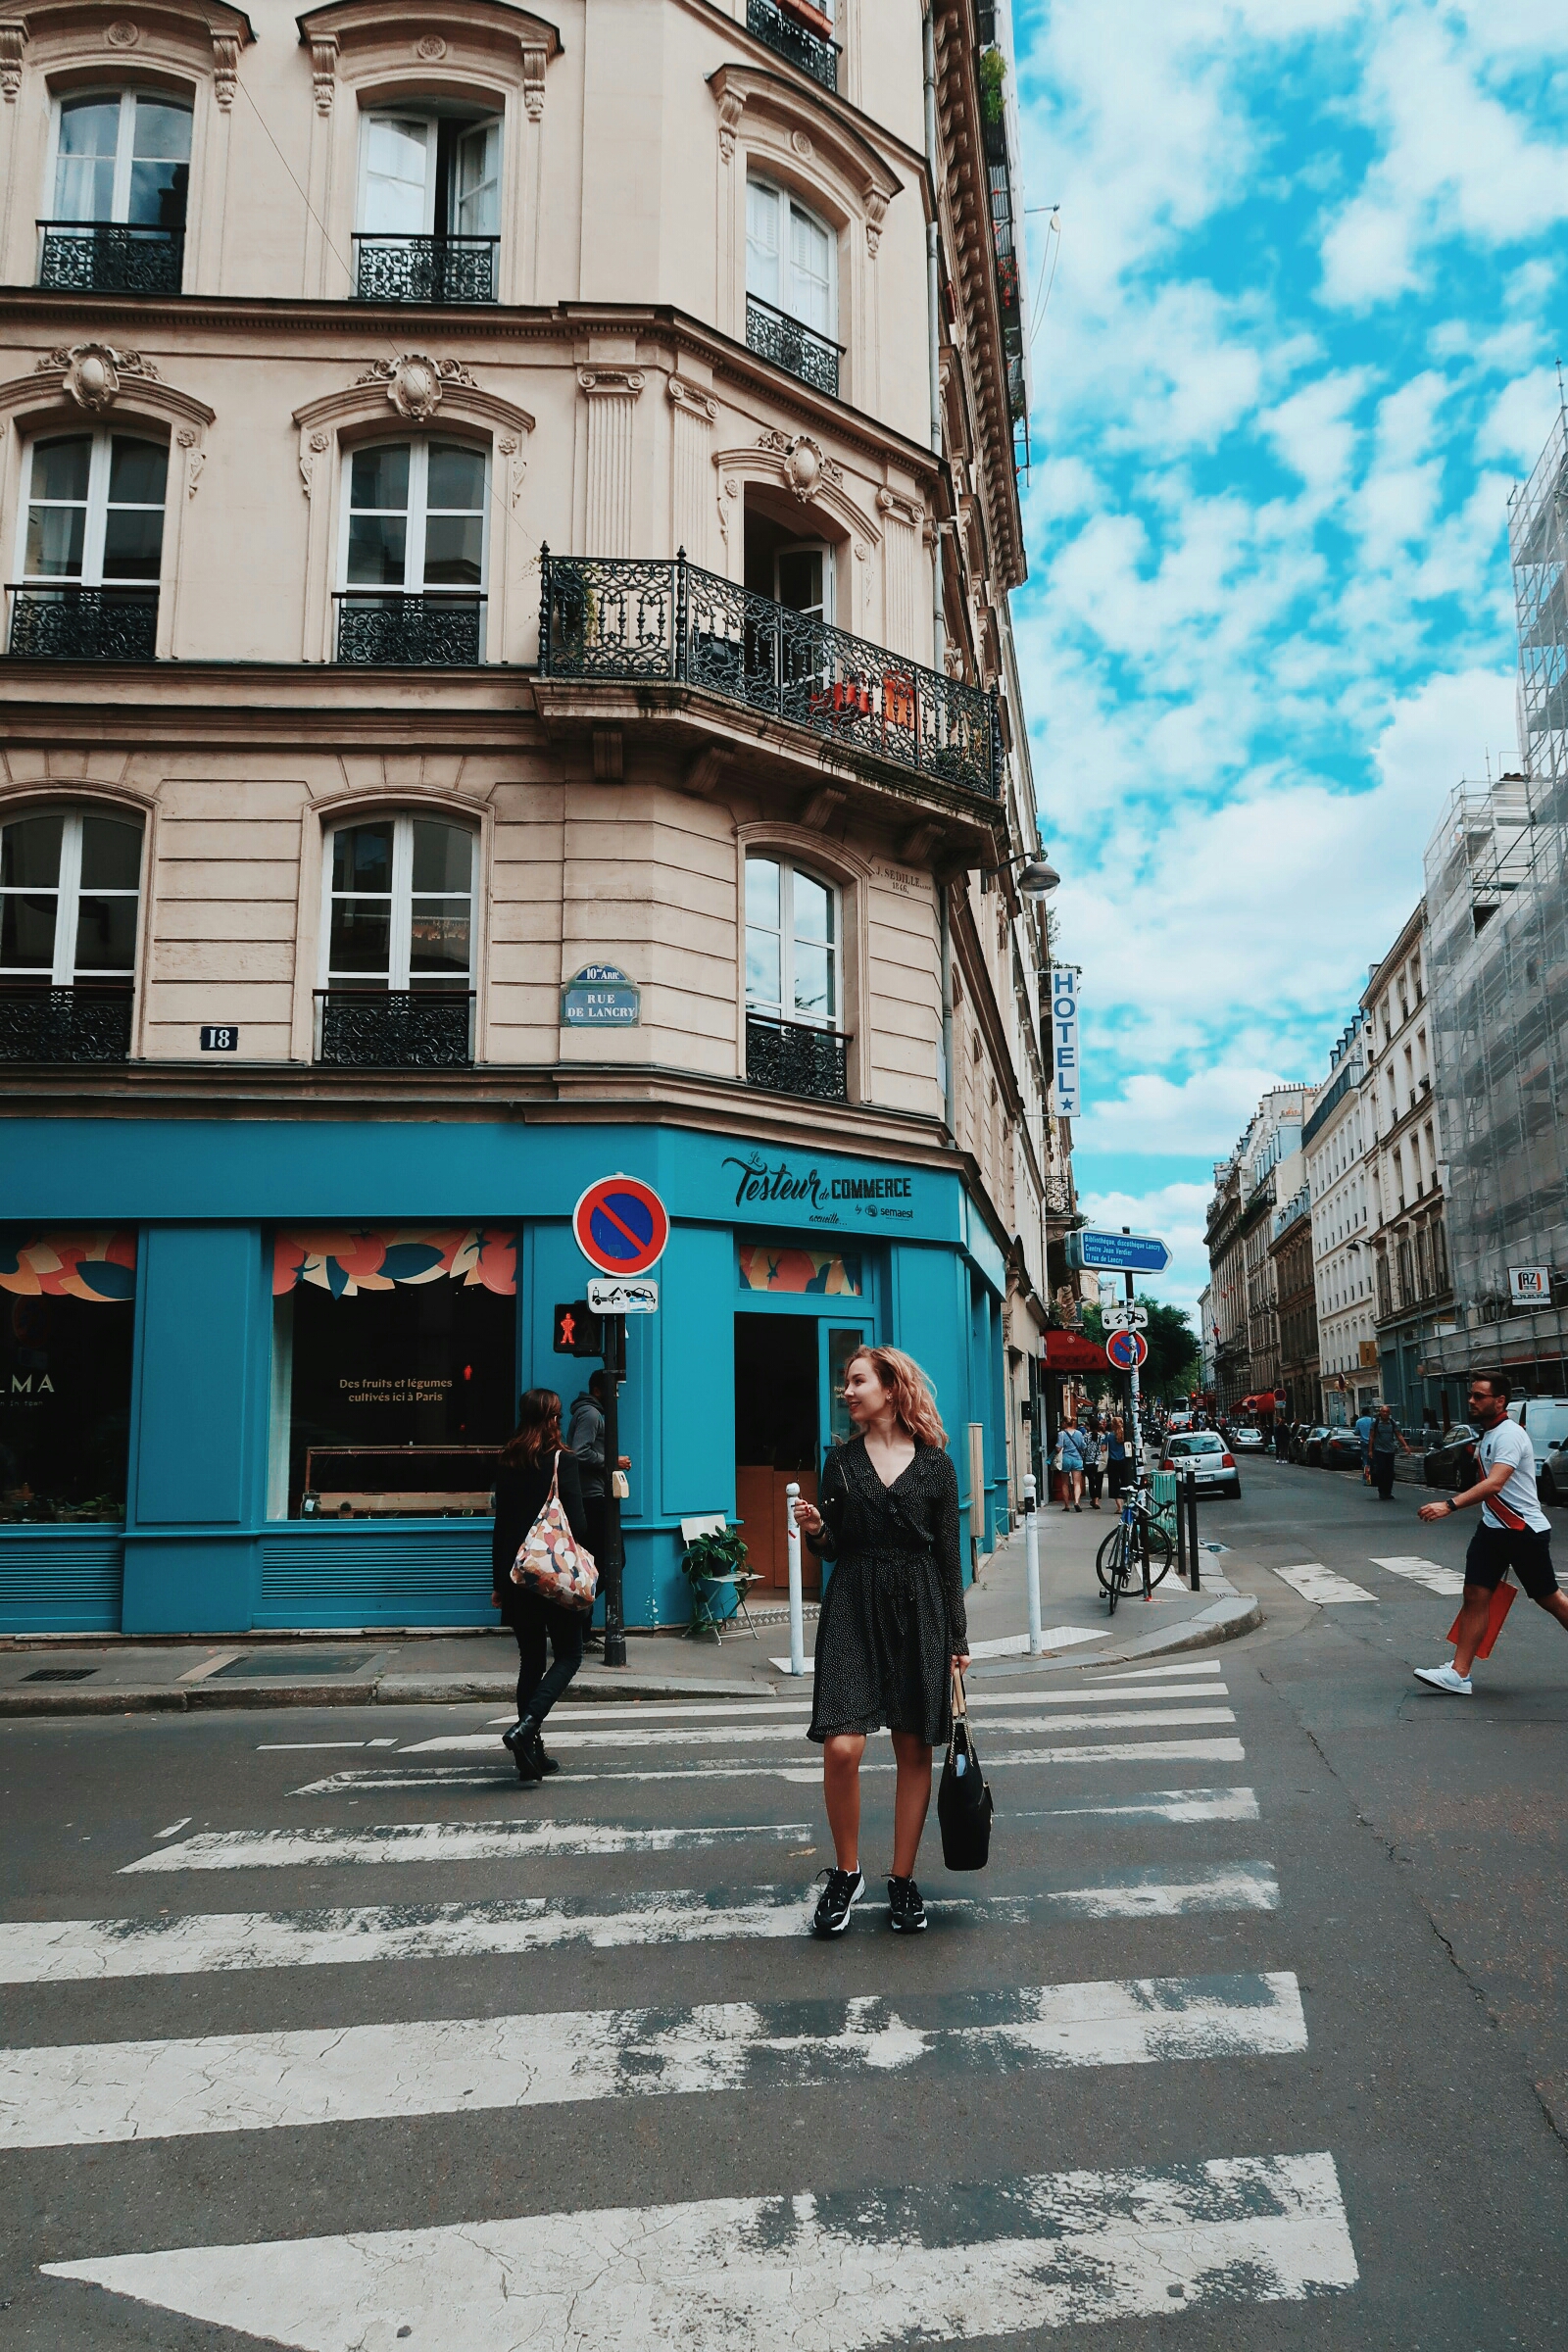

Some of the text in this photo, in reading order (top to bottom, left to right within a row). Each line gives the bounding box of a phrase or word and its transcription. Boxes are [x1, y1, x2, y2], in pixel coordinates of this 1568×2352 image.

[588, 995, 615, 1004] RUE
[568, 1007, 635, 1017] DE LANCRY
[1054, 973, 1075, 1093] HOTEL
[209, 1029, 230, 1049] 18
[747, 1151, 762, 1167] Le
[721, 1157, 911, 1210] Testeur de COMMERCE
[880, 1207, 913, 1219] semaest
[1086, 1244, 1102, 1253] Centre
[1146, 1243, 1160, 1251] Lancry
[1107, 1255, 1123, 1265] Lancry
[1522, 1272, 1537, 1285] AZ
[0, 1374, 55, 1393] MA
[339, 1378, 453, 1389] Des fruits et légumes
[348, 1392, 443, 1401] cultivés ici à Paris
